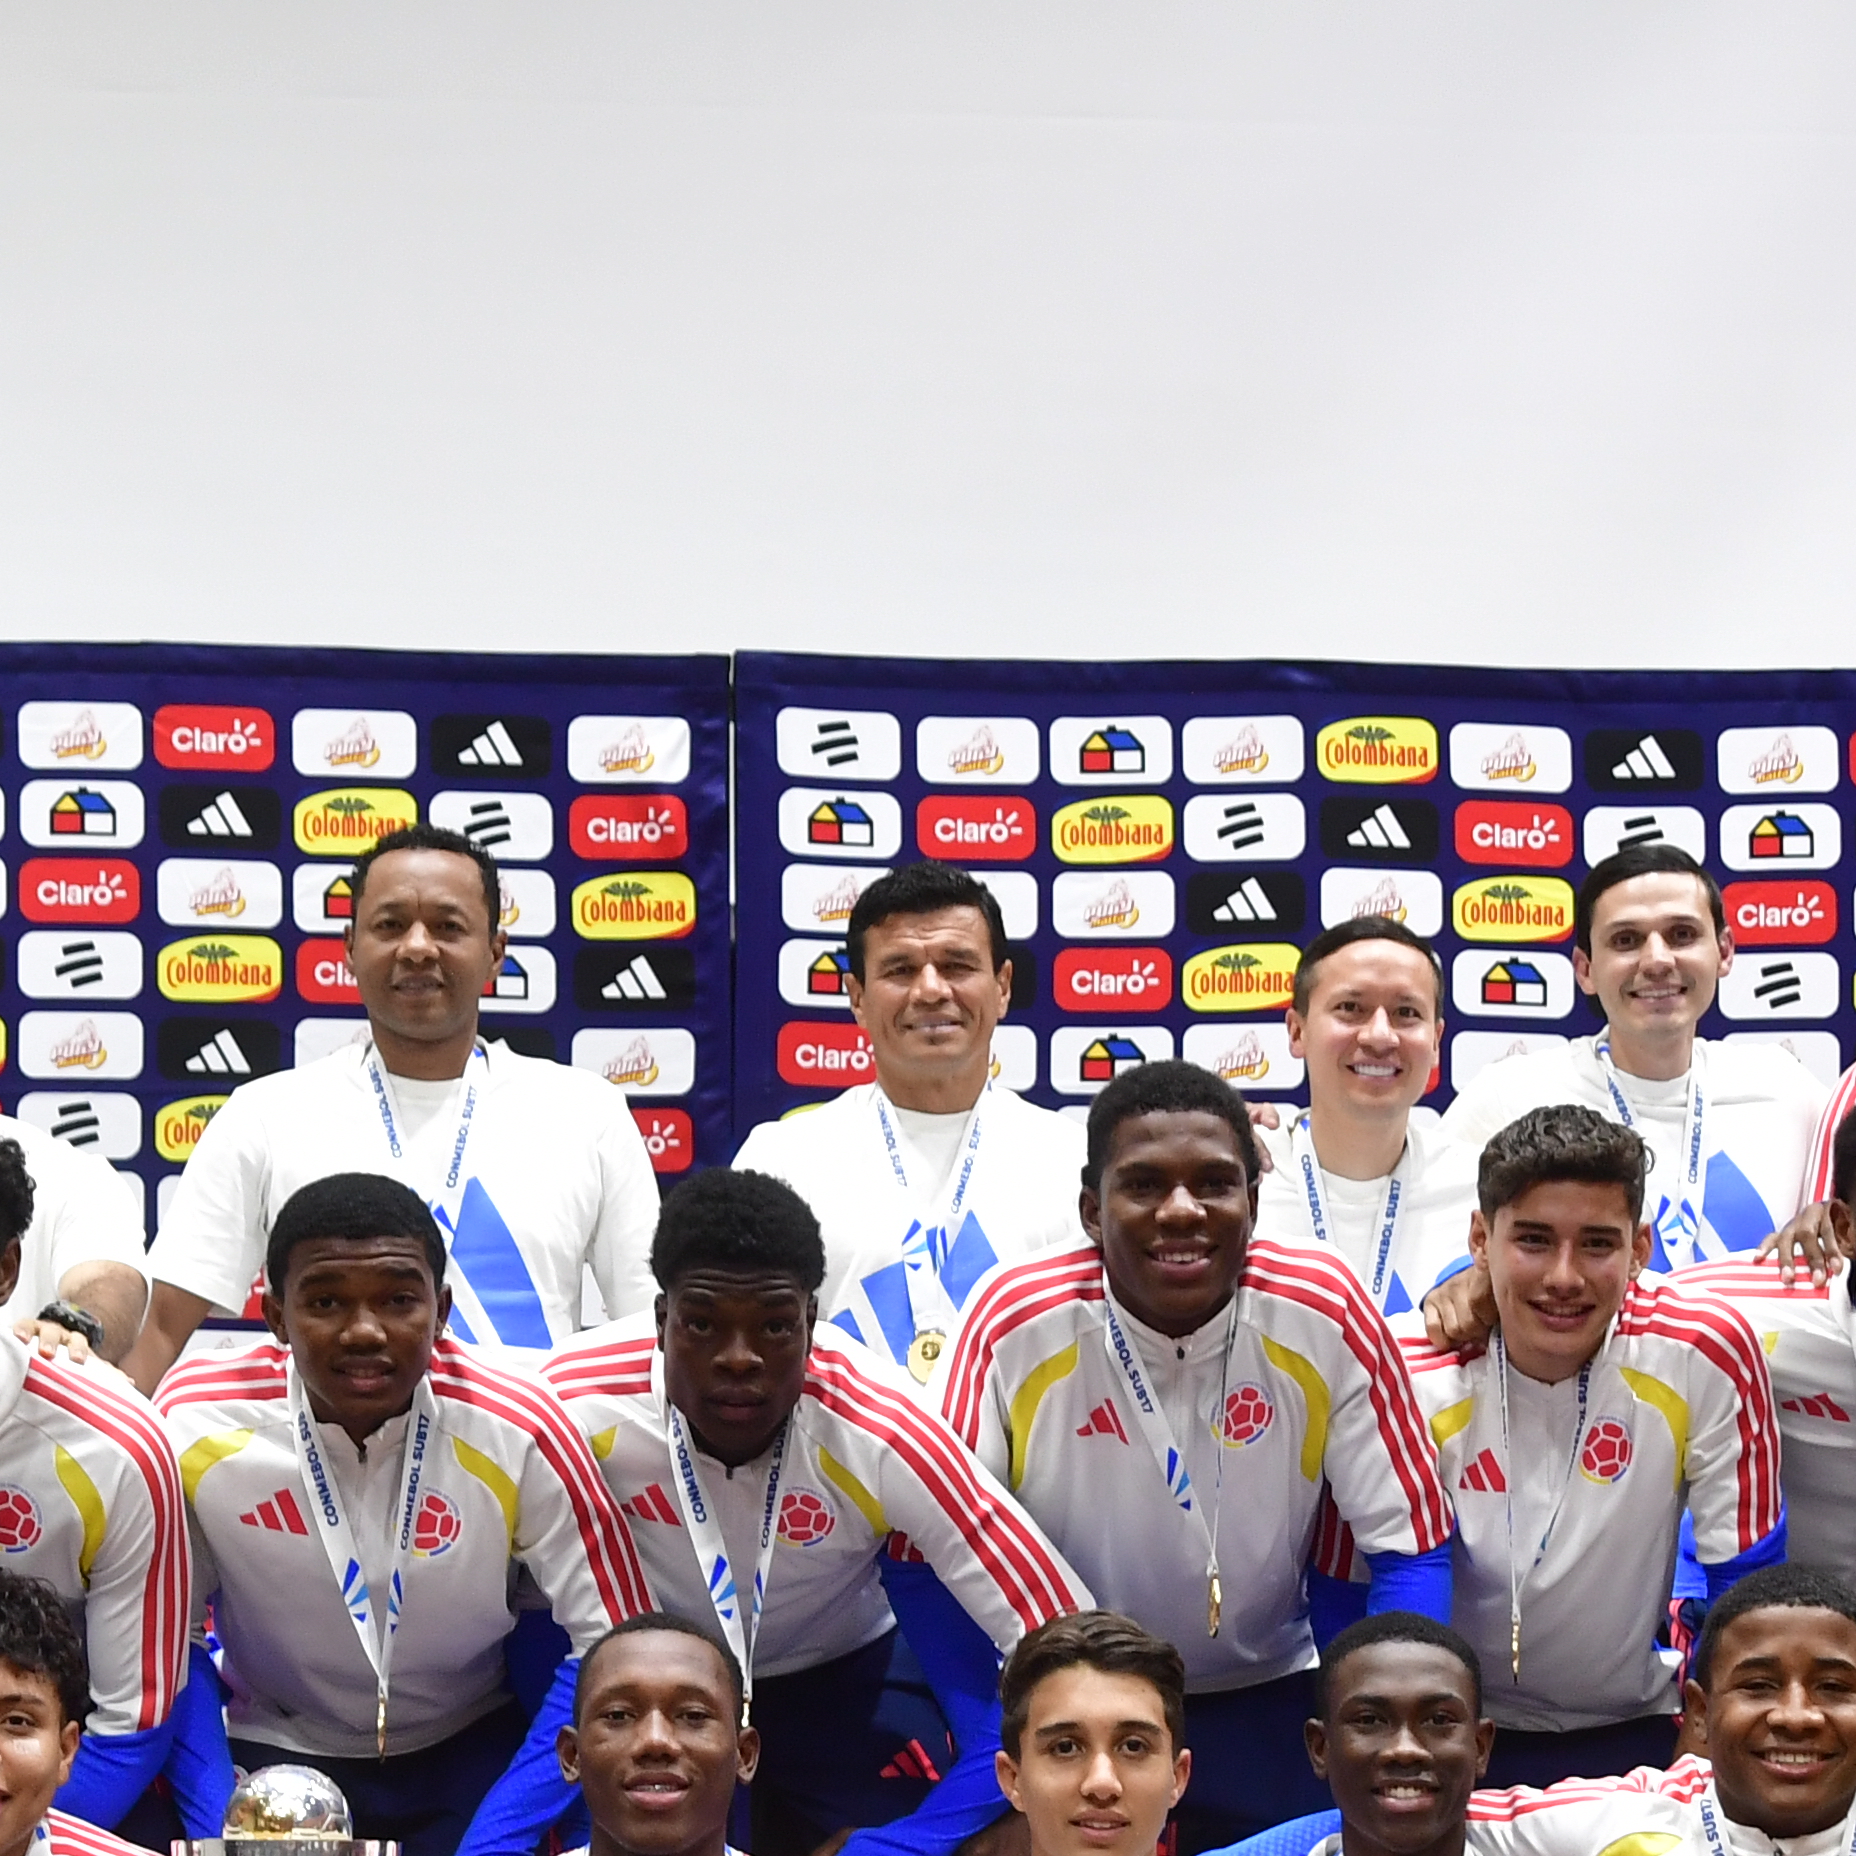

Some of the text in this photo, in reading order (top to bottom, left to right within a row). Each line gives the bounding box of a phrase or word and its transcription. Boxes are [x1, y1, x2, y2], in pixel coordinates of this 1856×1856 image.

[171, 726, 246, 754] Claro
[1325, 737, 1429, 769] Colombiana
[587, 815, 662, 843] Claro
[935, 814, 1009, 843] Claro
[1060, 818, 1164, 851] Colombiana
[1472, 820, 1547, 850] Claro
[37, 879, 112, 907] Claro
[580, 891, 686, 924] Colombiana
[1461, 896, 1565, 928] Colombiana
[1736, 900, 1811, 929] Claro
[166, 954, 272, 987] Colombiana
[314, 960, 358, 987] Cla
[1071, 966, 1146, 995] Claro
[795, 1043, 873, 1070] Claro
[446, 1122, 470, 1188] CONMEBOL
[1688, 1121, 1703, 1184] CONMEBOL
[951, 1153, 976, 1214] CONMEBOL
[1301, 1154, 1323, 1227] CONMEBOL
[1373, 1179, 1401, 1295] CONMEBOL SUB17
[1128, 1369, 1155, 1416] SUB17
[307, 1452, 339, 1527] CONMEBOL
[400, 1413, 430, 1550] CONMEBOL SUB17
[678, 1445, 707, 1523] CONMEBOL
[760, 1461, 781, 1548] CONMEBOL
[1699, 1798, 1720, 1850] SUB17
